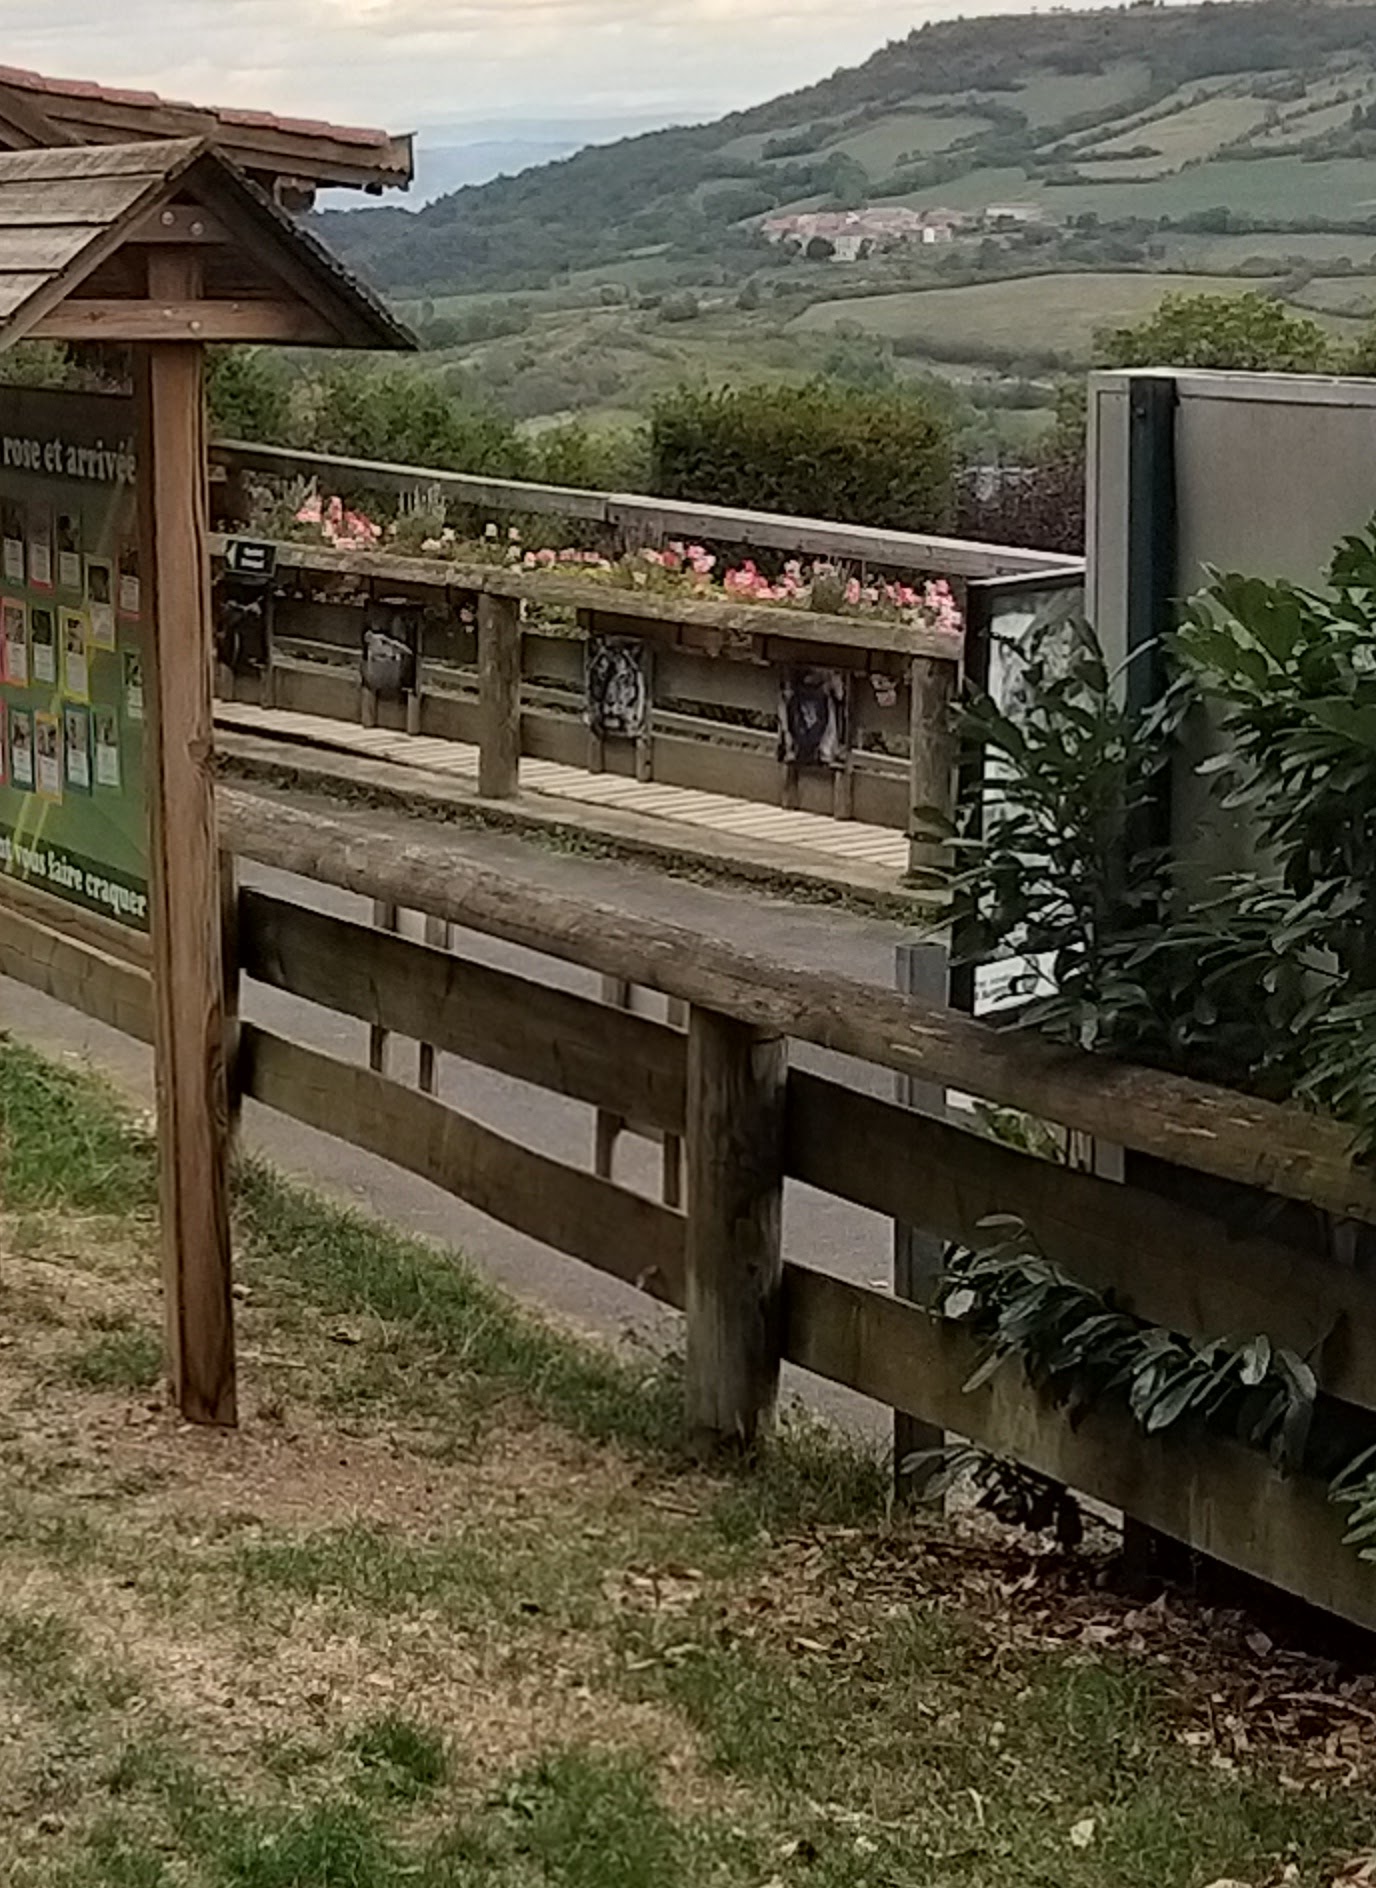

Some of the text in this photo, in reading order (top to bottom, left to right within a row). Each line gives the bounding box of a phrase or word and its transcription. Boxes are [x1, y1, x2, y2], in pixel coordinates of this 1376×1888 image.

[3, 436, 41, 471] rose
[44, 439, 64, 473] et
[47, 850, 83, 891] faire
[85, 873, 147, 917] craquer
